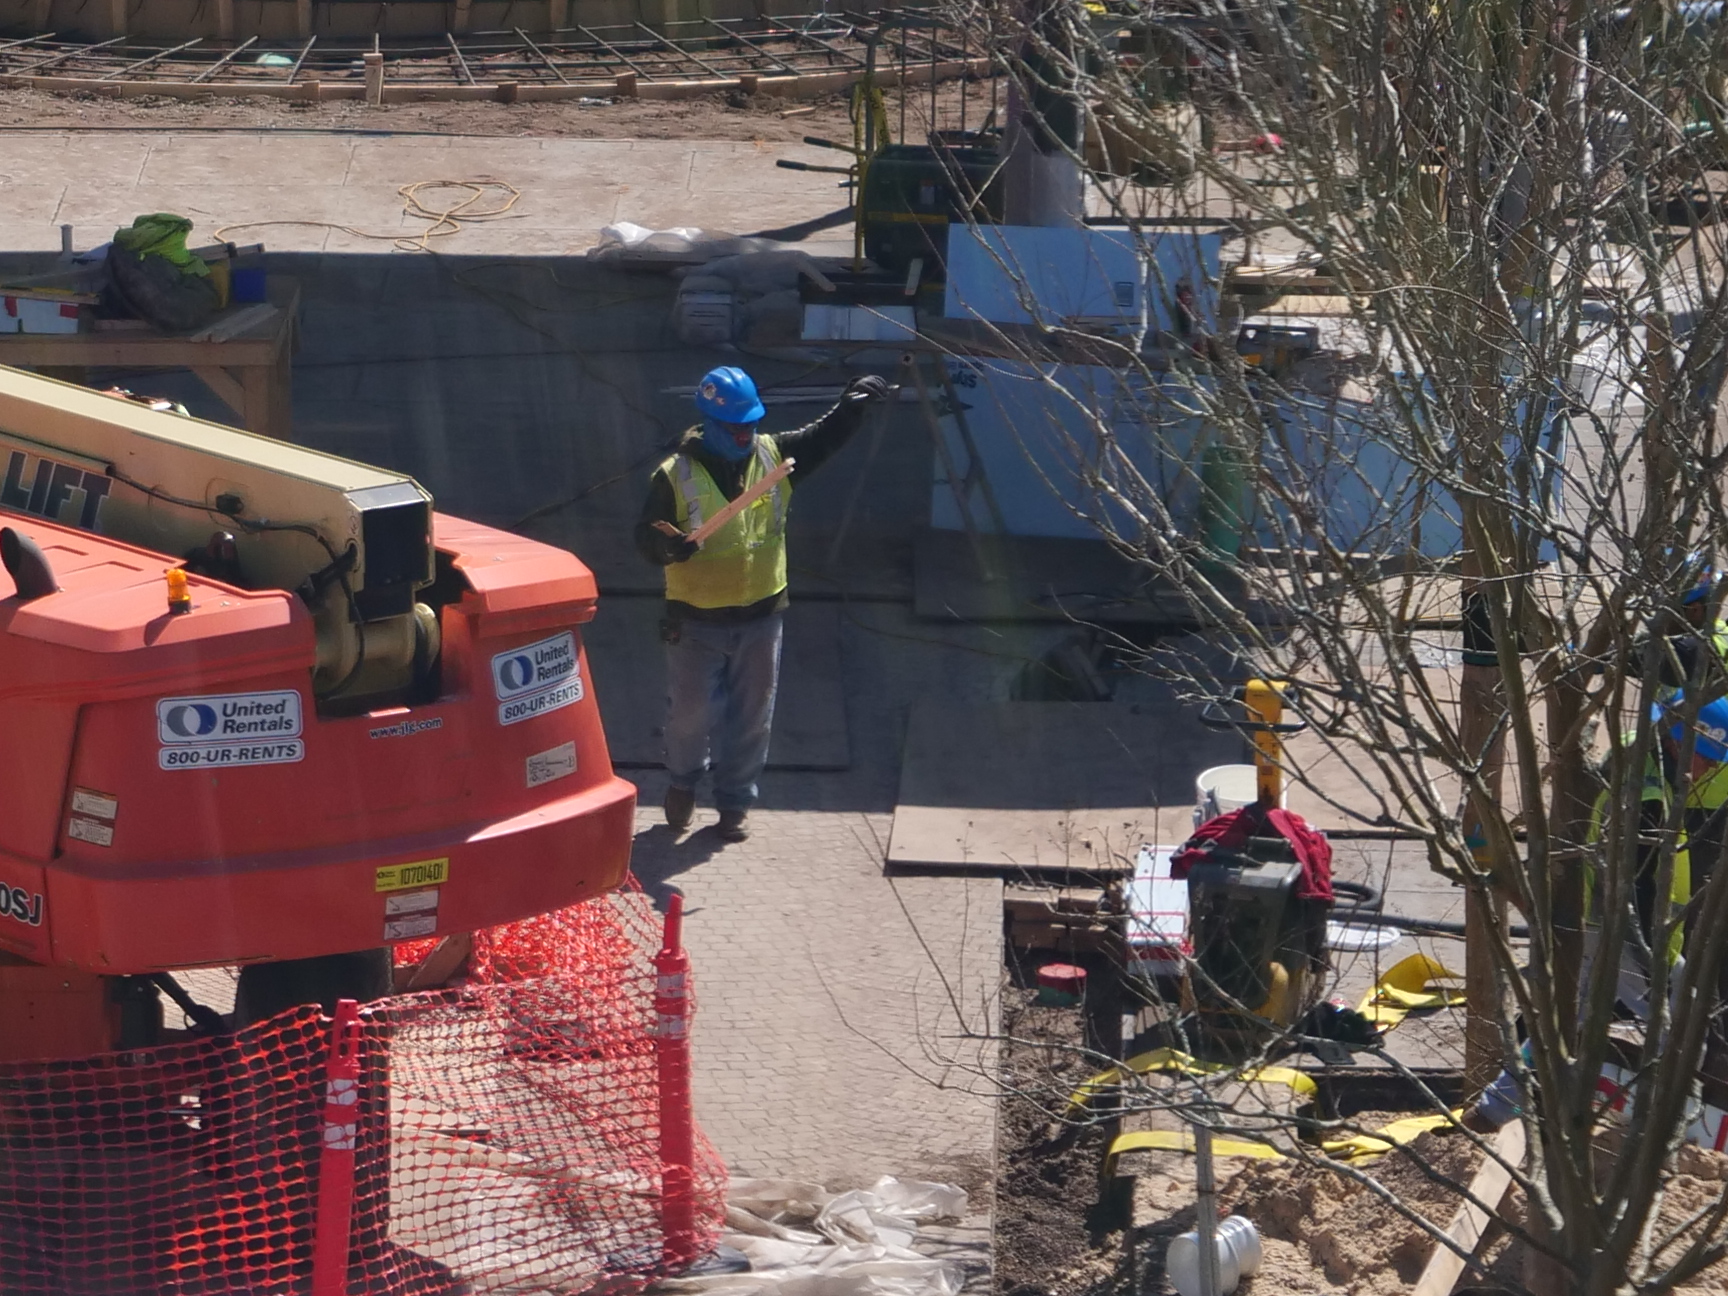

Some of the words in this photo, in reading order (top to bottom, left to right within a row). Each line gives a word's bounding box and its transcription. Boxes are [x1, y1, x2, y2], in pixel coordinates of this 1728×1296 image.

[0, 450, 113, 530] LIFT
[535, 642, 570, 666] United
[537, 658, 574, 681] Rentals
[222, 699, 286, 718] United
[504, 684, 580, 720] 800-UR-RENTS
[222, 716, 293, 734] Rentals
[370, 717, 442, 738] www.jlg.com
[167, 744, 297, 765] 800-UR-RENTS
